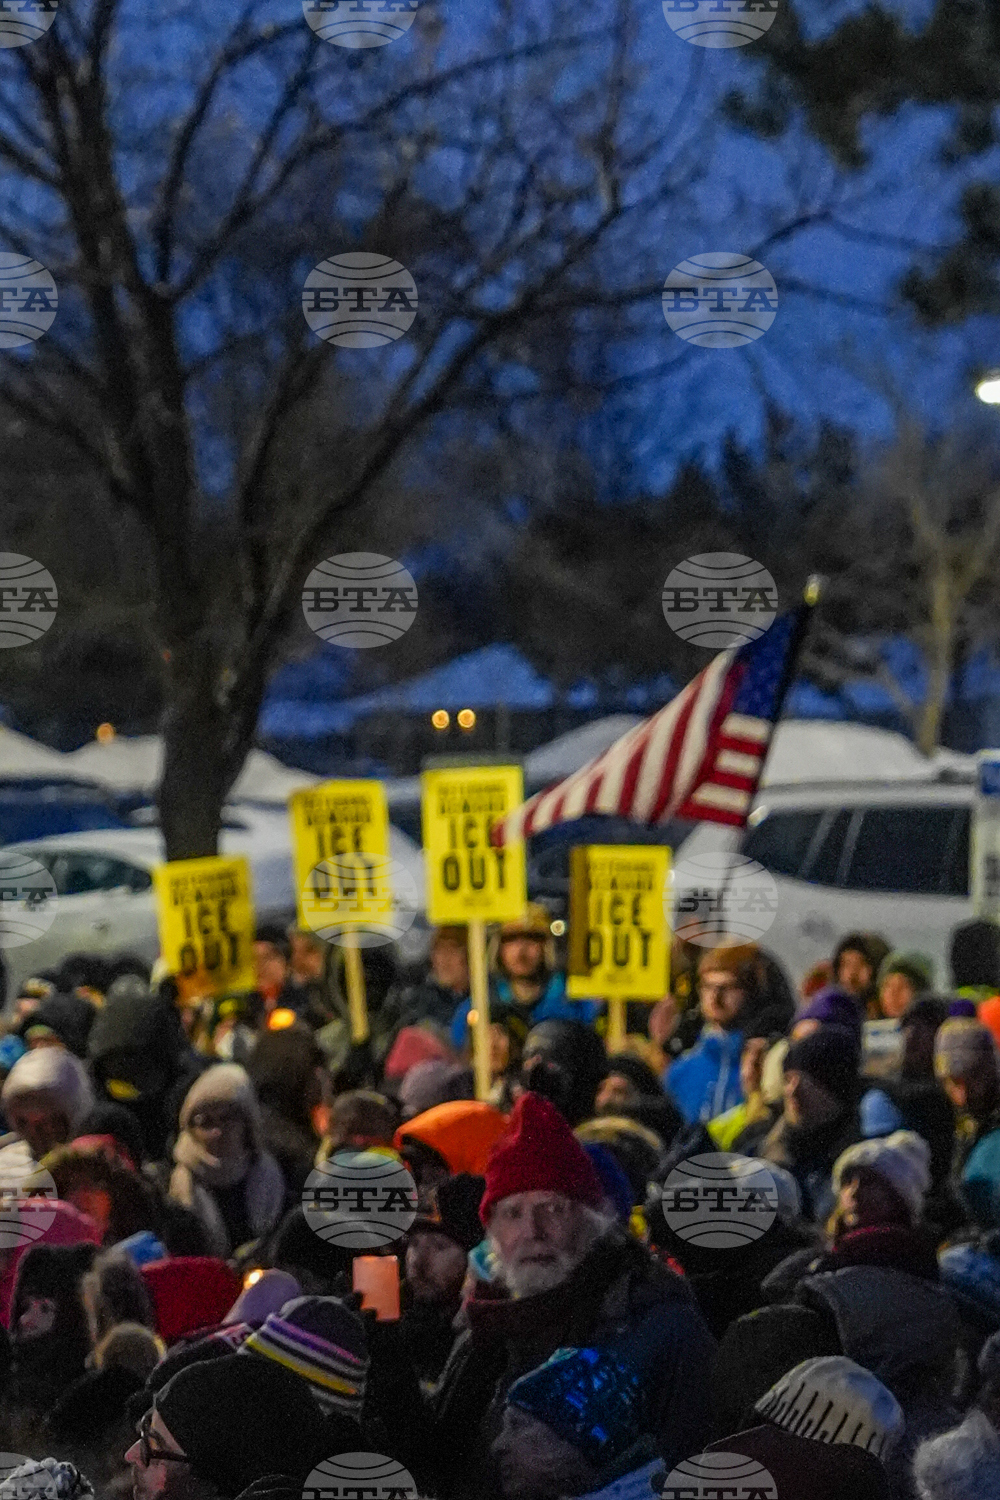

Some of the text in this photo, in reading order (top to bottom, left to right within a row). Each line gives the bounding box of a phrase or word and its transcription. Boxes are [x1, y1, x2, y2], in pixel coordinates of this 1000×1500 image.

[316, 824, 367, 858] ICE
[444, 849, 511, 891] OUT
[183, 898, 231, 938] ICE
[597, 893, 645, 926] ICE
[179, 931, 242, 977] OUT
[586, 929, 653, 967] OUT
